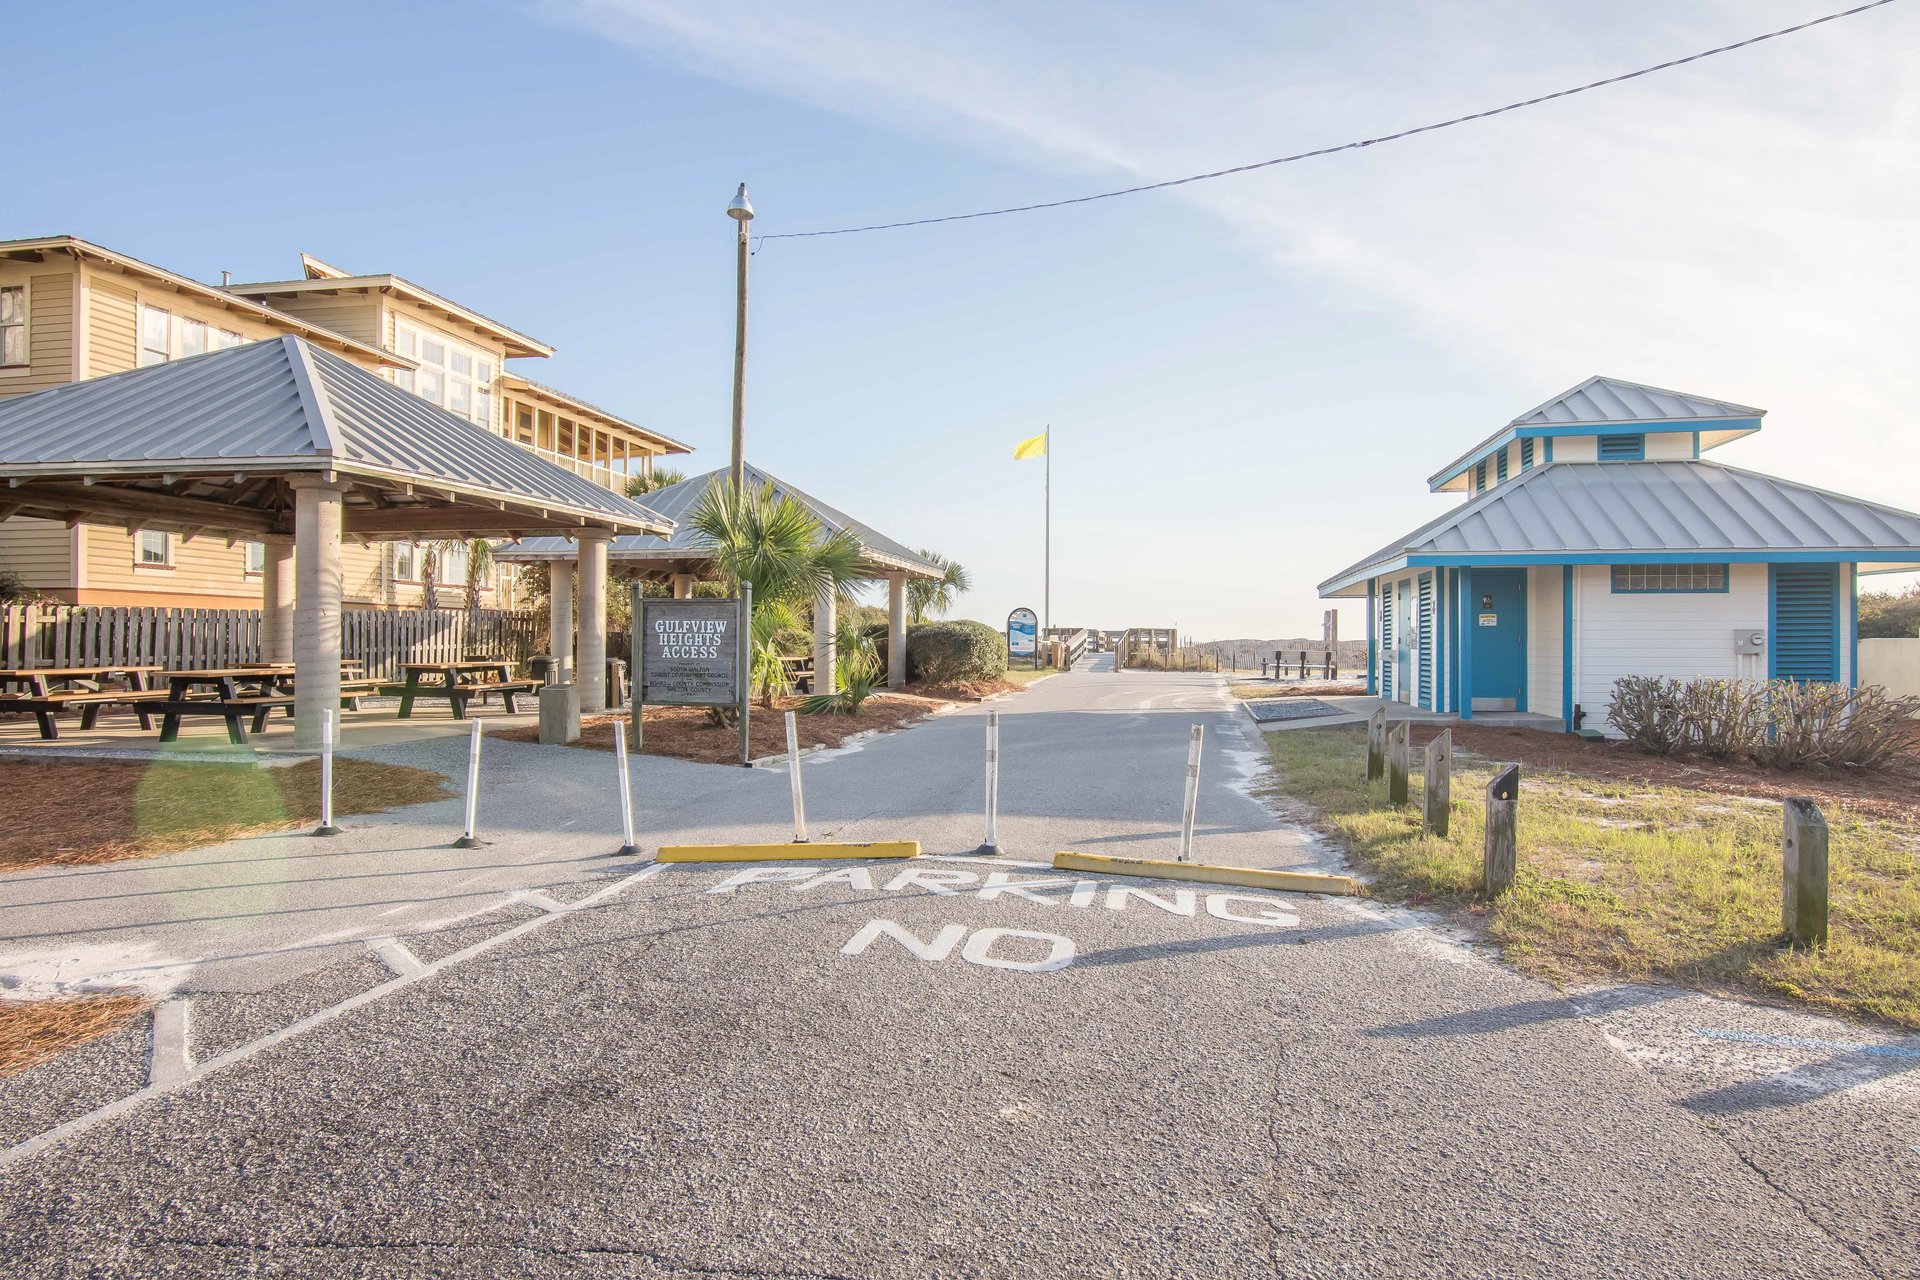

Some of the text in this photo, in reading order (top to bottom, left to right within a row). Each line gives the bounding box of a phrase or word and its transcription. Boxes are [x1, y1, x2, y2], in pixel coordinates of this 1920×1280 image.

[655, 620, 727, 633] GULFVIEW
[659, 633, 721, 646] HEIGHTS
[662, 646, 718, 659] ACCESS
[706, 866, 1301, 927] PARKING
[839, 919, 1077, 973] NO
